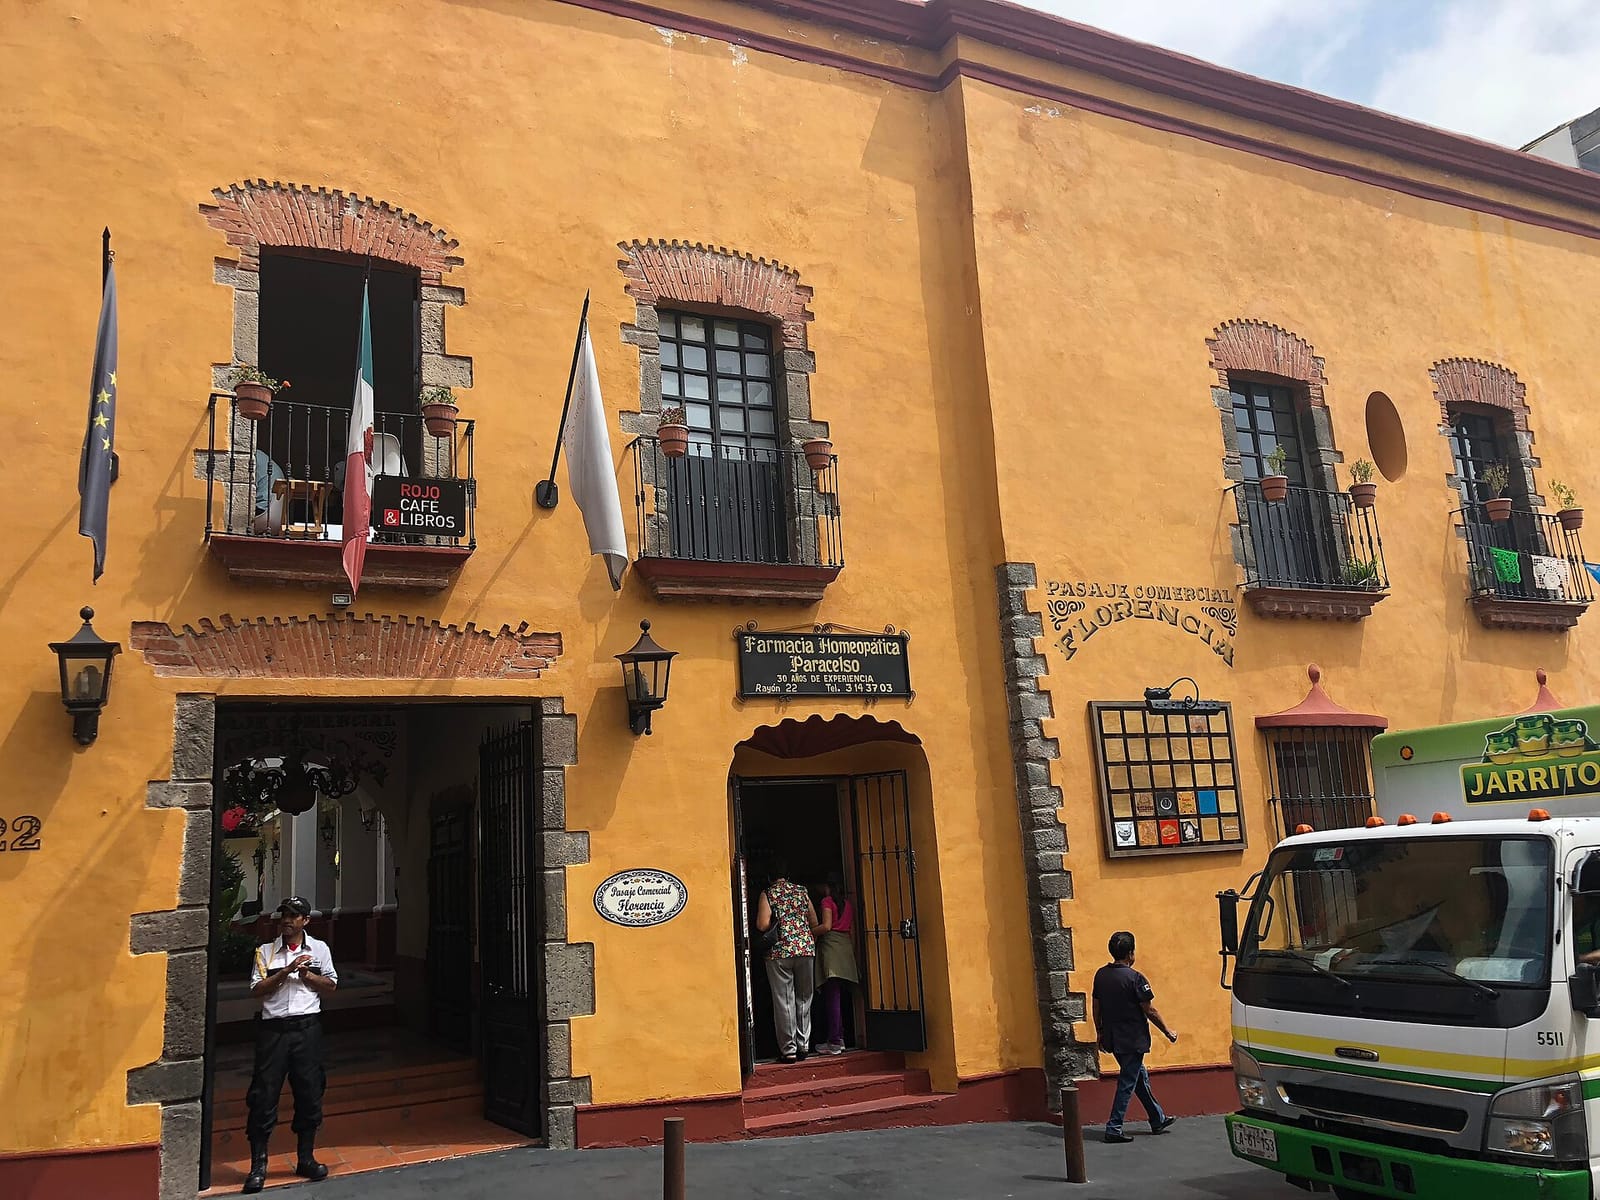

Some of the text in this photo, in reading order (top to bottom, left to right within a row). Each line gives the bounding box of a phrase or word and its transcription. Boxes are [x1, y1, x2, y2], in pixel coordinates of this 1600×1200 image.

[401, 484, 440, 499] ROJO
[400, 513, 455, 528] LIBROS
[1046, 580, 1235, 603] PASAJE COMERCIAL
[1054, 599, 1235, 667] FLORENCIA
[744, 635, 901, 657] Farmacia Homeopática
[790, 655, 861, 673] Paracelso
[777, 673, 875, 683] 30 AÑOS DE EXPERIENCIA
[755, 683, 781, 694] Rayón
[785, 683, 798, 693] 22
[825, 683, 841, 693] Tel.
[1471, 761, 1600, 796] JARRITO
[611, 884, 672, 899] Pasaje Comercial
[617, 898, 666, 912] Florencia
[1537, 1031, 1564, 1046] 5511
